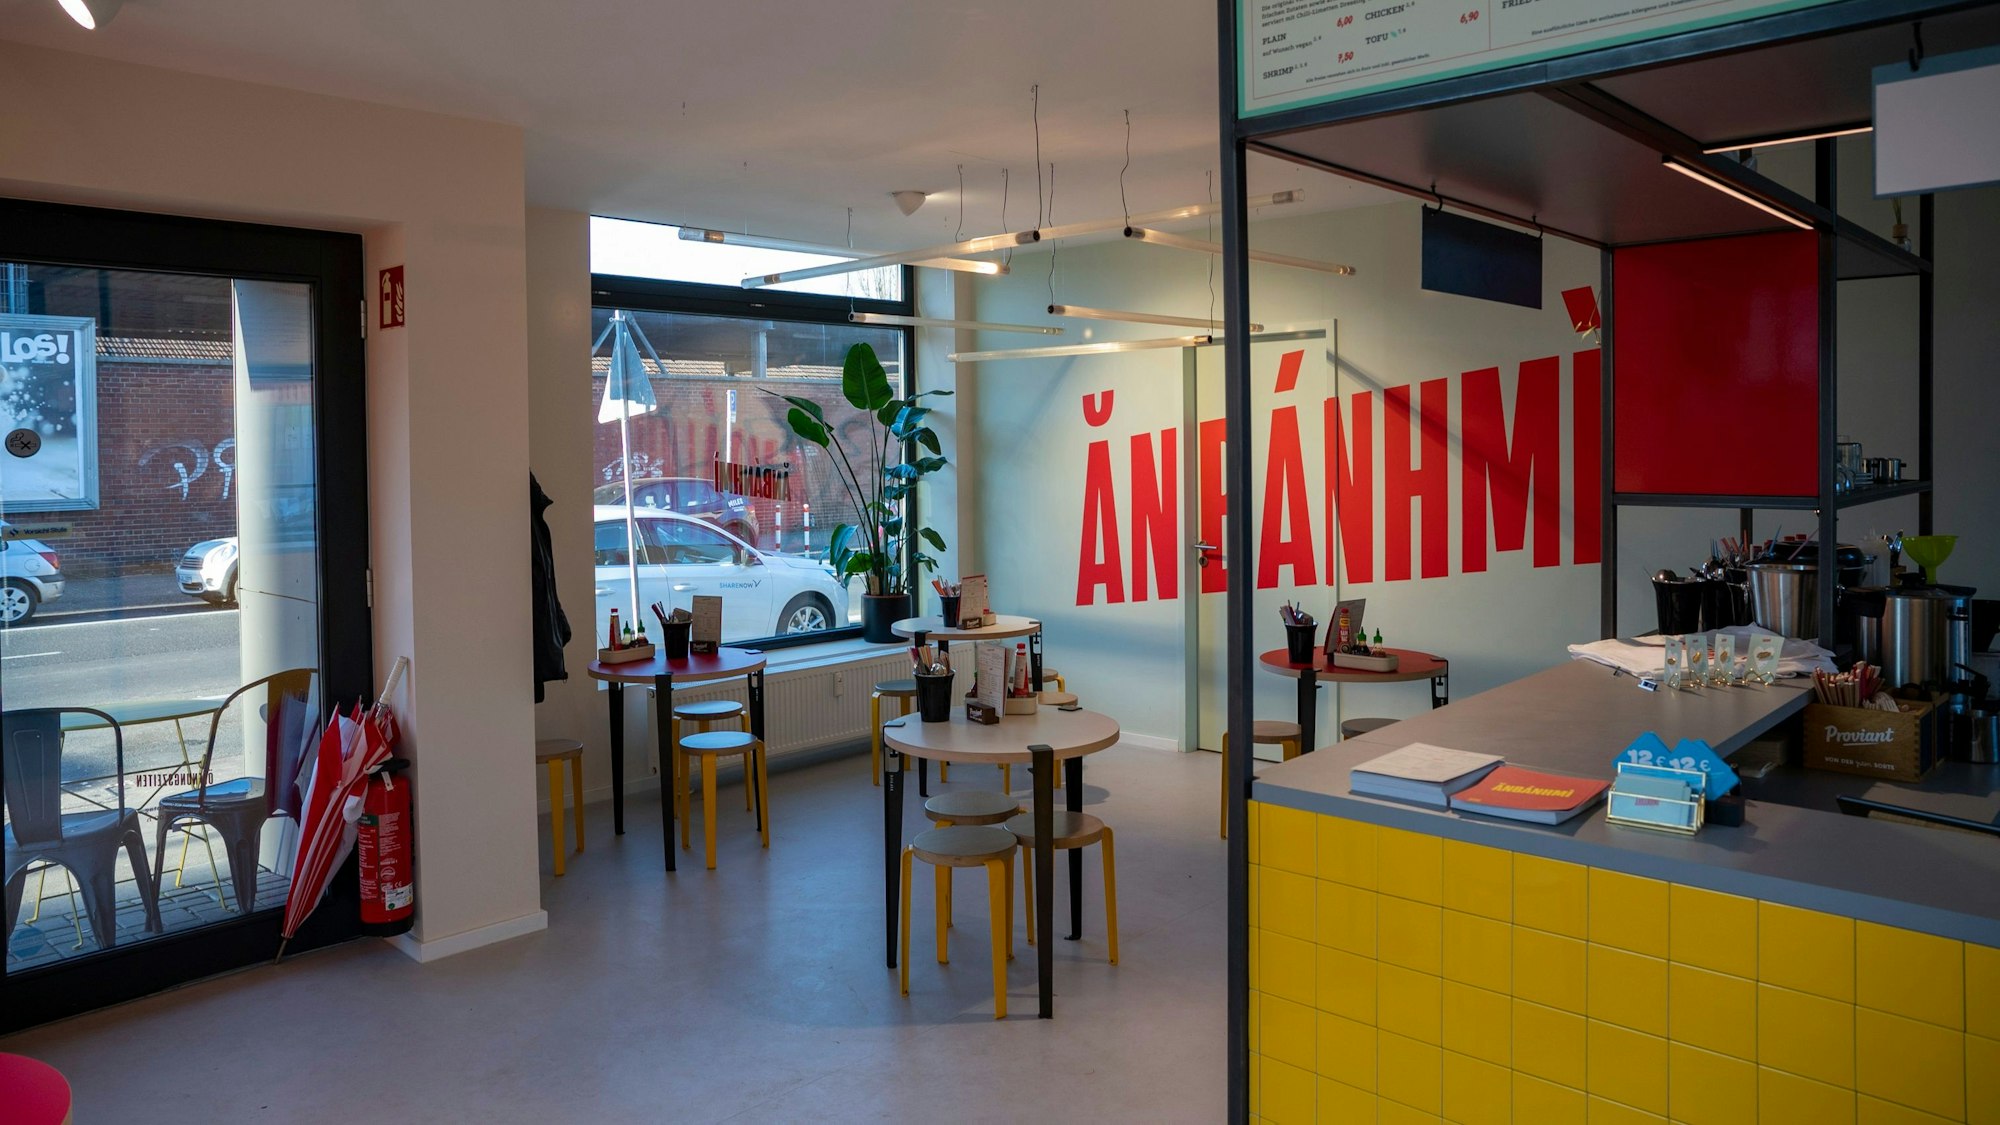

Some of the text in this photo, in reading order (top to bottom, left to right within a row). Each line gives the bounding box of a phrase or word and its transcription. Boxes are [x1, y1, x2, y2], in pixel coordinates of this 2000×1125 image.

[1365, 5, 1405, 20] CHICKEN
[1460, 10, 1479, 24] 6,90
[1262, 33, 1287, 45] PLAIN
[1365, 32, 1389, 45] TOFU
[1262, 66, 1294, 80] SHRIMP
[1825, 725, 1895, 743] Proviant
